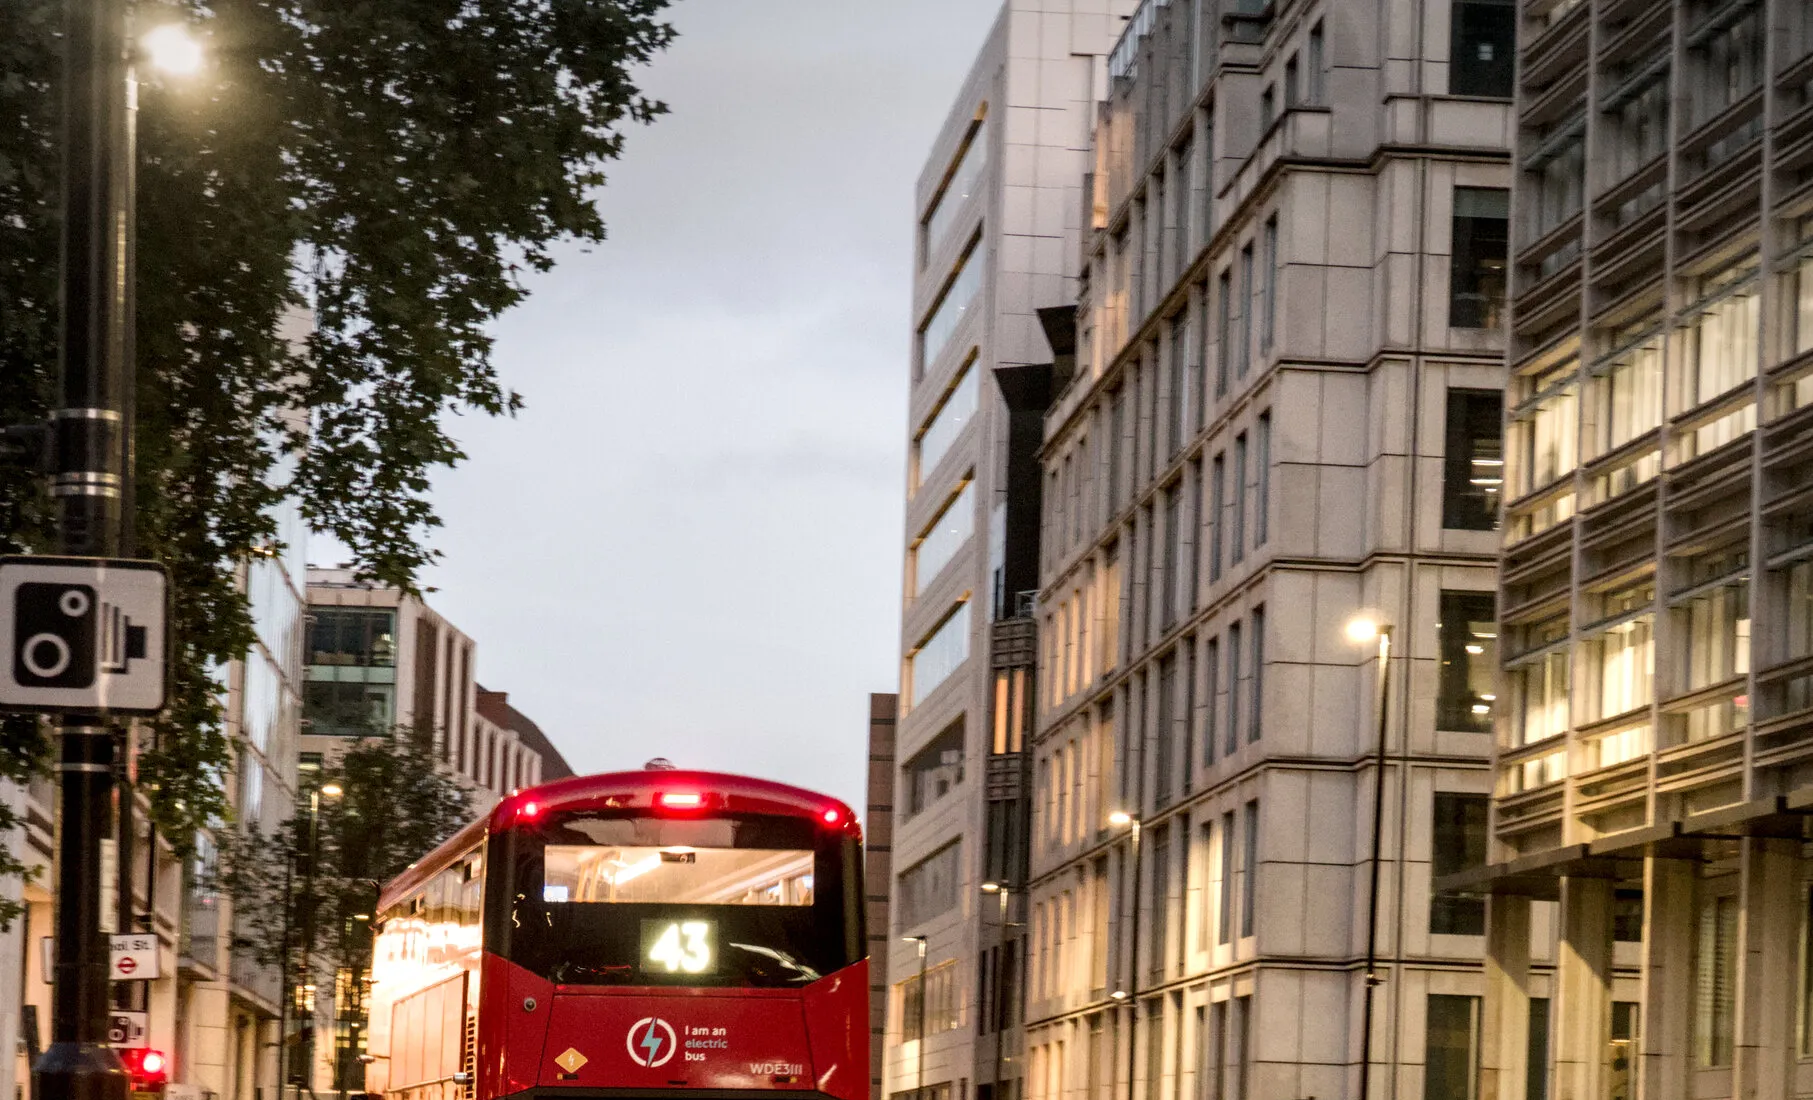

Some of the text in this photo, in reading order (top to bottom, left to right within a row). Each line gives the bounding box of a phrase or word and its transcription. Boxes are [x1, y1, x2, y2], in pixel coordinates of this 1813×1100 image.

[649, 922, 712, 972] 43
[685, 1026, 726, 1036] I am an
[684, 1038, 728, 1049] electric
[684, 1051, 706, 1061] bus
